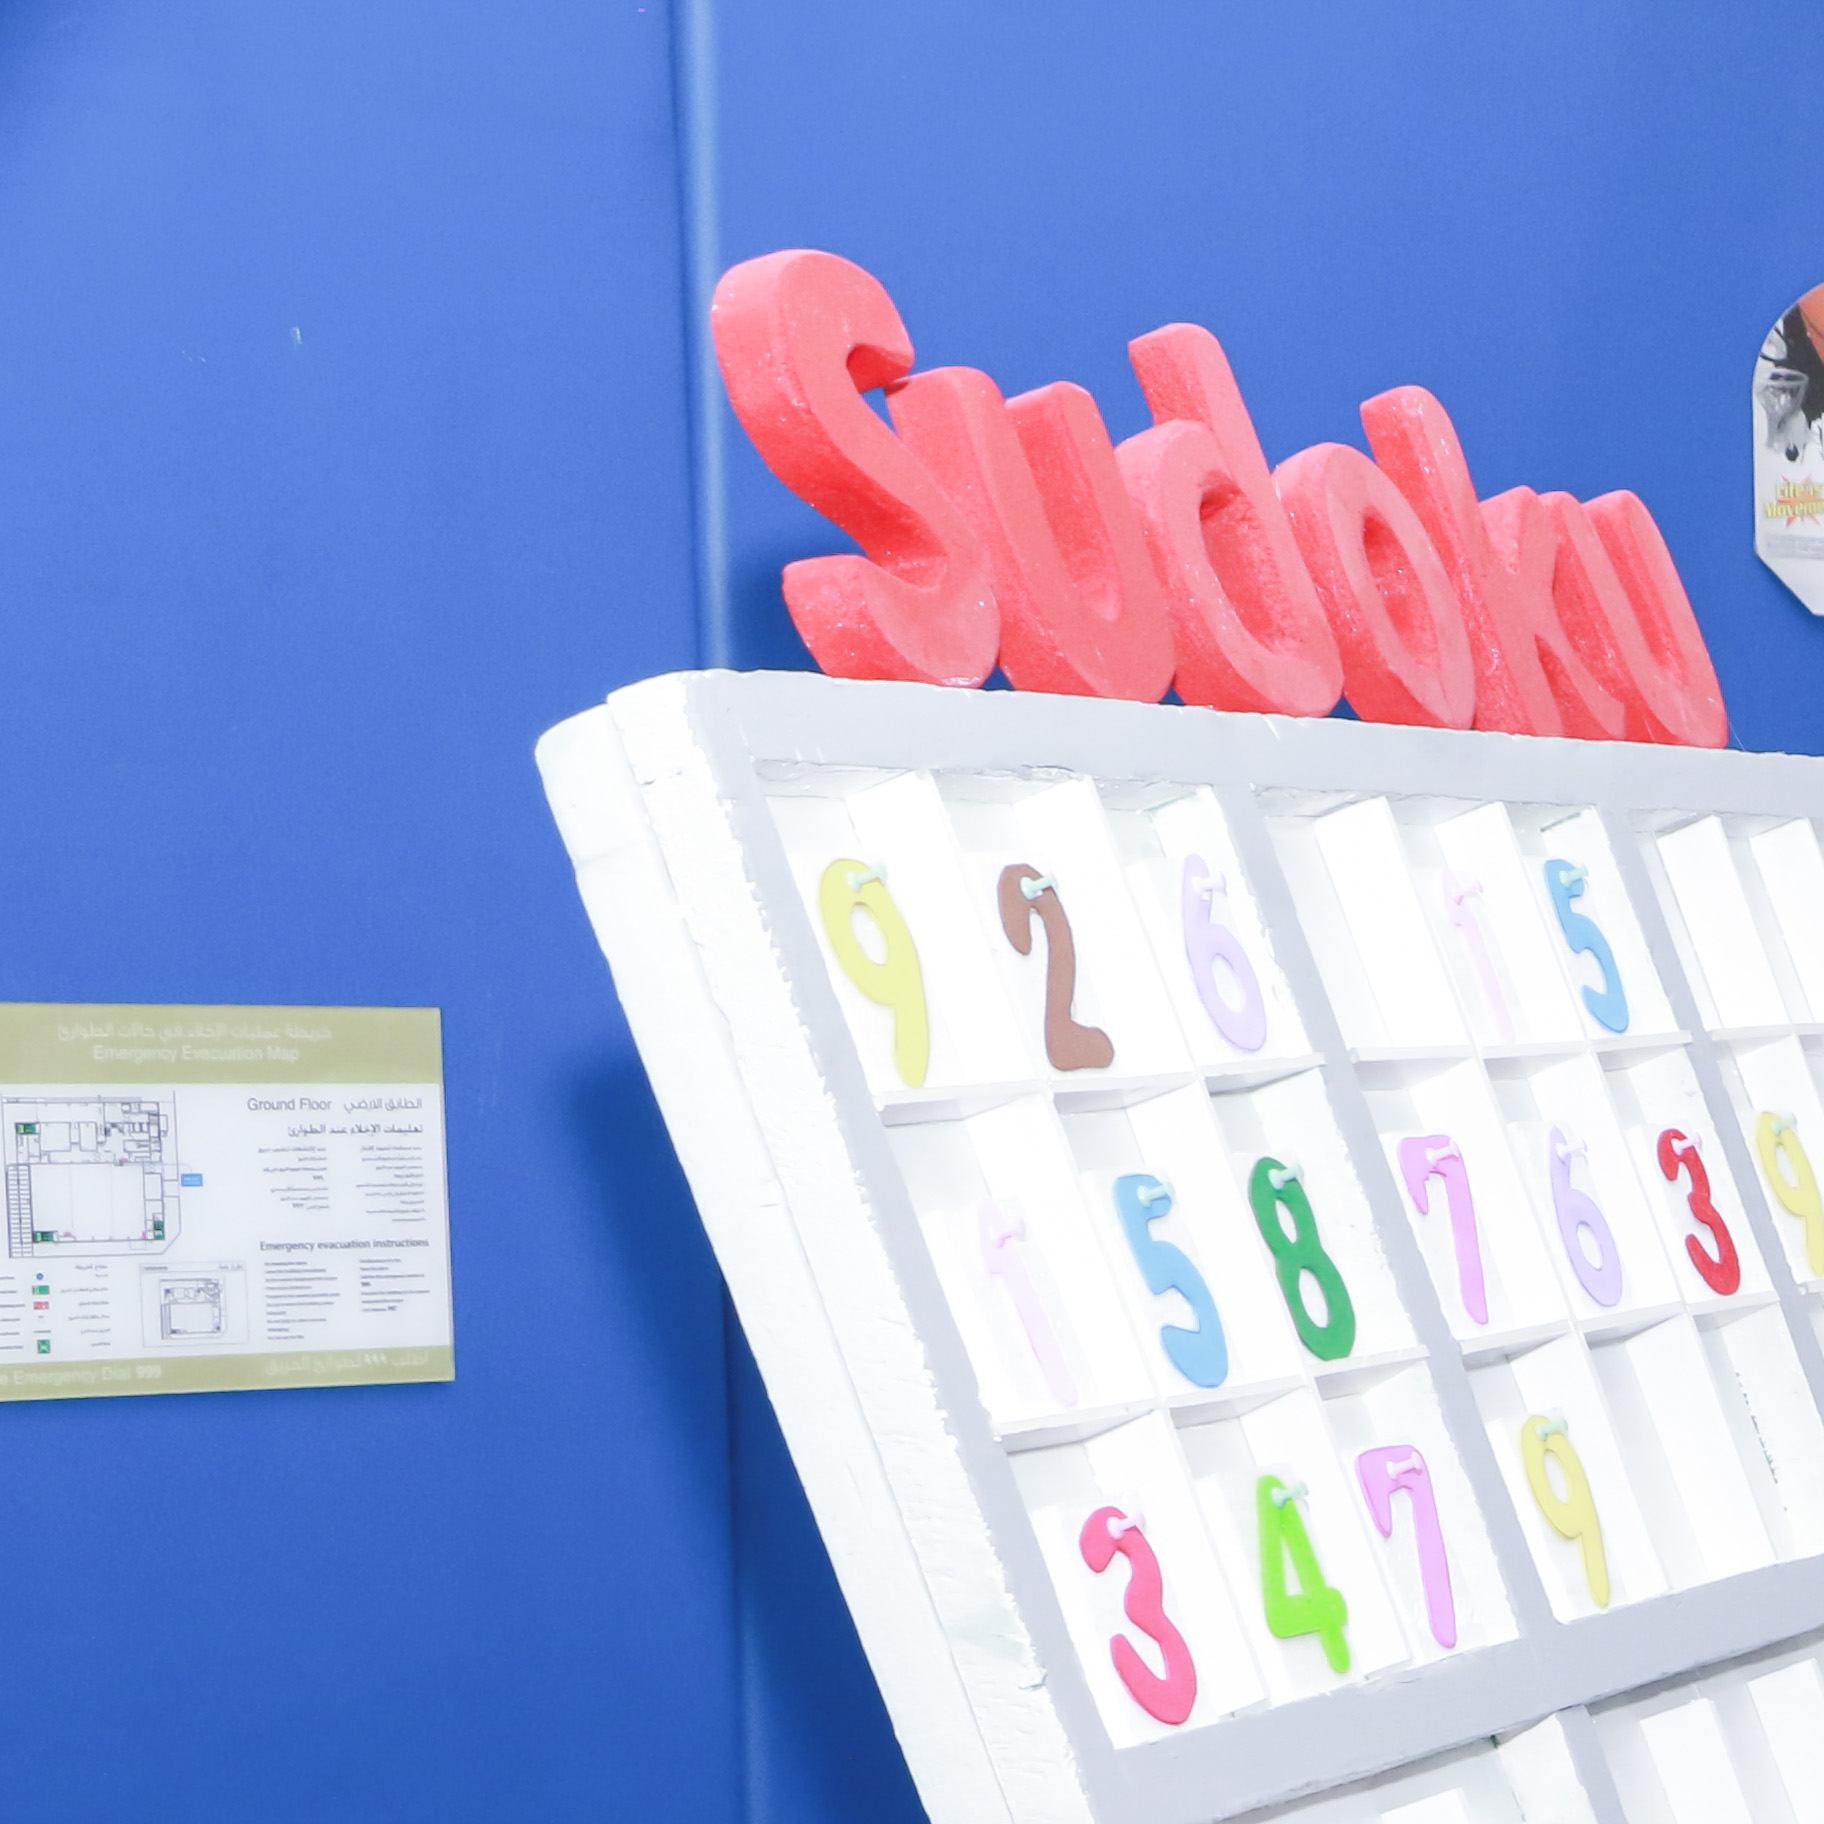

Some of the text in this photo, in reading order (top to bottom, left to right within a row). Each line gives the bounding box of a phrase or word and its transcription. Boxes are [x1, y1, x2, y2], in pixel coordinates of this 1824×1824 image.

[711, 248, 1729, 748] Sudoku
[819, 853, 1630, 1089] 9 2 6 1 5
[92, 1044, 300, 1064] Emergency Evacuation Map
[246, 1097, 332, 1112] Ground Floor
[259, 1238, 429, 1253] Emergency evacuation instructions
[978, 1203, 1077, 1406] 1
[1112, 1173, 1229, 1388] 5
[1248, 1156, 1356, 1362] 8
[1396, 1133, 1489, 1326] 7
[1549, 1124, 1623, 1308] 6
[1656, 1127, 1741, 1296] 3
[13, 1369, 97, 1387] Emergency
[101, 1366, 131, 1381] Dial
[1079, 1506, 1197, 1726] 3
[1257, 1474, 1351, 1673] 4
[1354, 1444, 1458, 1650] 7
[1520, 1414, 1610, 1609] 9
